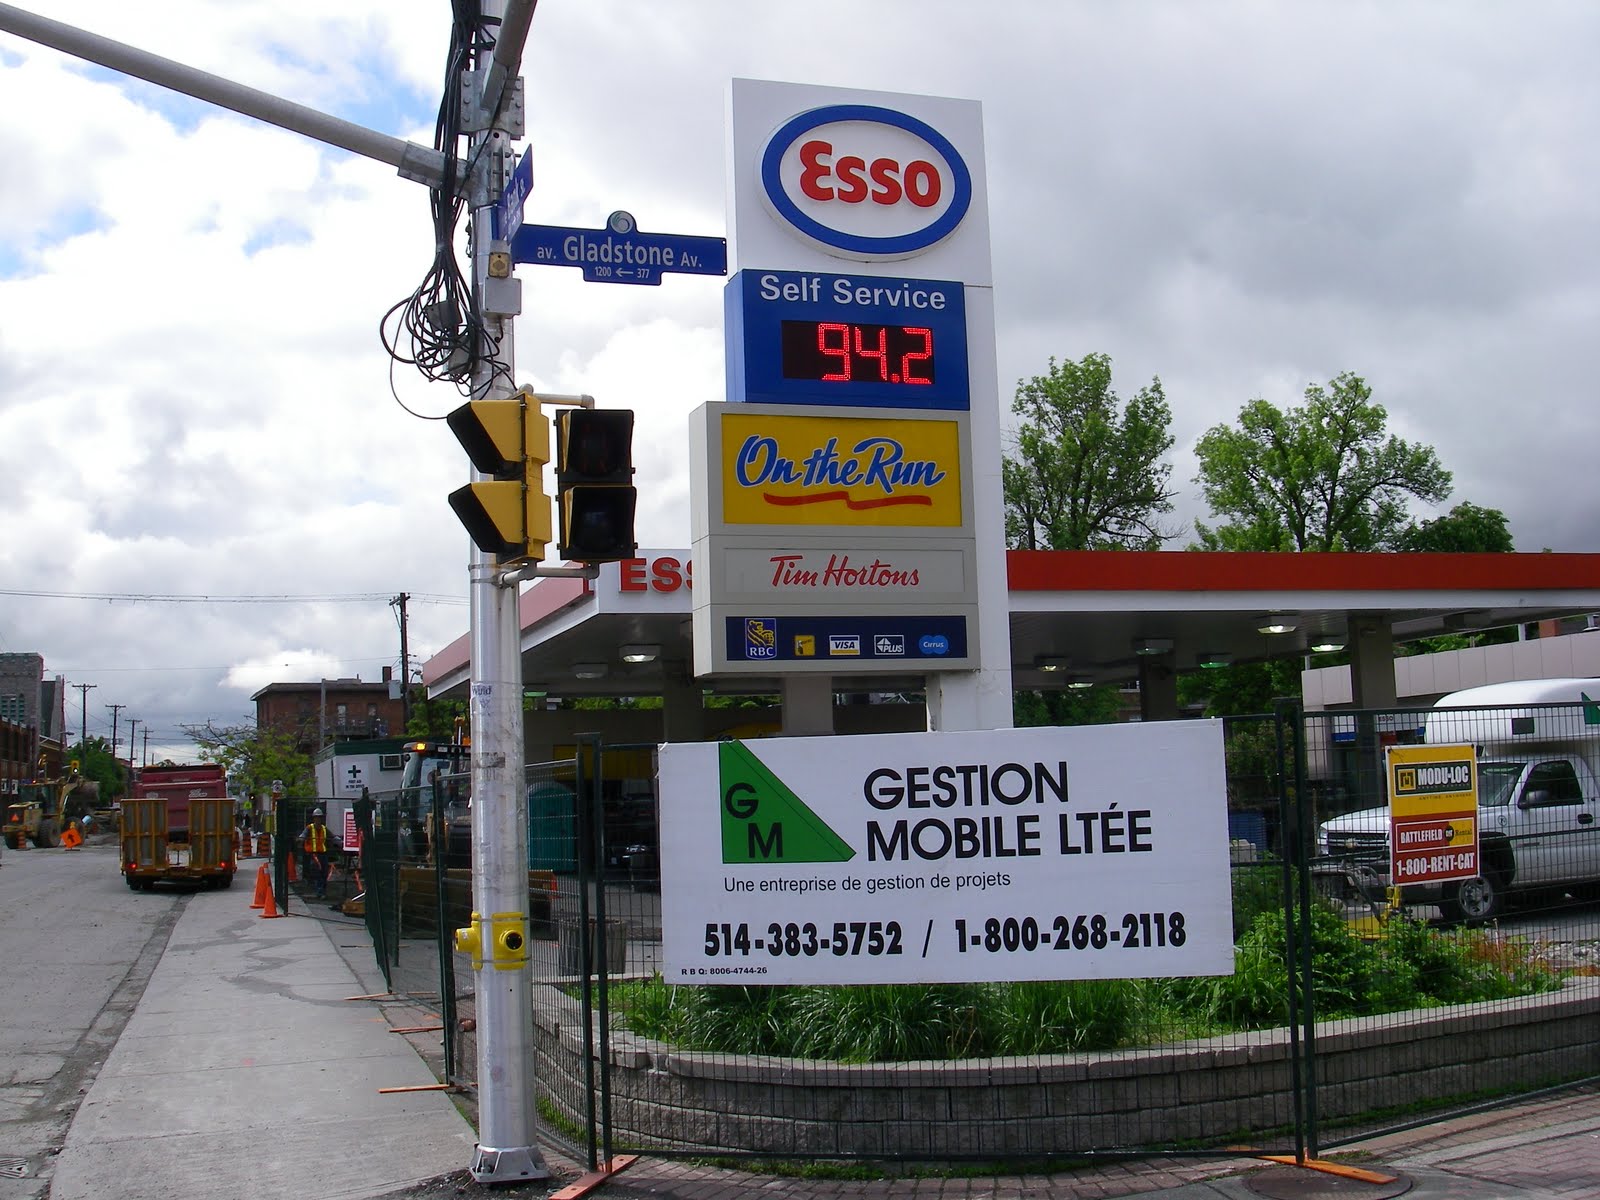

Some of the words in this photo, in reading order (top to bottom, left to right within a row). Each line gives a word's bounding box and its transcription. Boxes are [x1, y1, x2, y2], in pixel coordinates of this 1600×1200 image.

[537, 245, 557, 260] av.
[563, 235, 675, 267] Gladstone
[680, 254, 702, 268] Av.
[594, 266, 612, 278] 1200
[637, 268, 650, 280] 377
[760, 274, 821, 302] Self
[833, 278, 946, 310] Service
[818, 322, 933, 385] 94.2
[736, 434, 802, 488] On
[801, 437, 865, 487] the
[852, 437, 945, 495] Run
[620, 557, 692, 593] ES
[769, 554, 817, 587] Tim
[823, 553, 920, 588] Hortons
[749, 646, 774, 657] RBC
[834, 641, 856, 650] VISA
[883, 643, 903, 653] PLUS
[923, 641, 945, 649] Cirrus
[863, 761, 1070, 810] GESTION
[1418, 765, 1469, 786] MODU-LOC
[725, 782, 760, 819] G
[747, 821, 784, 859] M
[866, 815, 1042, 862] MOBILE
[1058, 802, 1153, 856] LTÉE
[1400, 828, 1443, 844] BATTLEFIELD
[1396, 852, 1475, 877] 1-800-RENT-CAT
[724, 877, 755, 892] Une
[759, 876, 837, 895] entreprise
[841, 876, 862, 891] de
[866, 873, 925, 894] gestion
[930, 873, 951, 889] de
[956, 871, 1011, 891] projets
[704, 920, 903, 957] 514-383-5752
[954, 911, 1187, 953] 1-800-268-2118
[709, 966, 768, 976] 8006-4744-26
